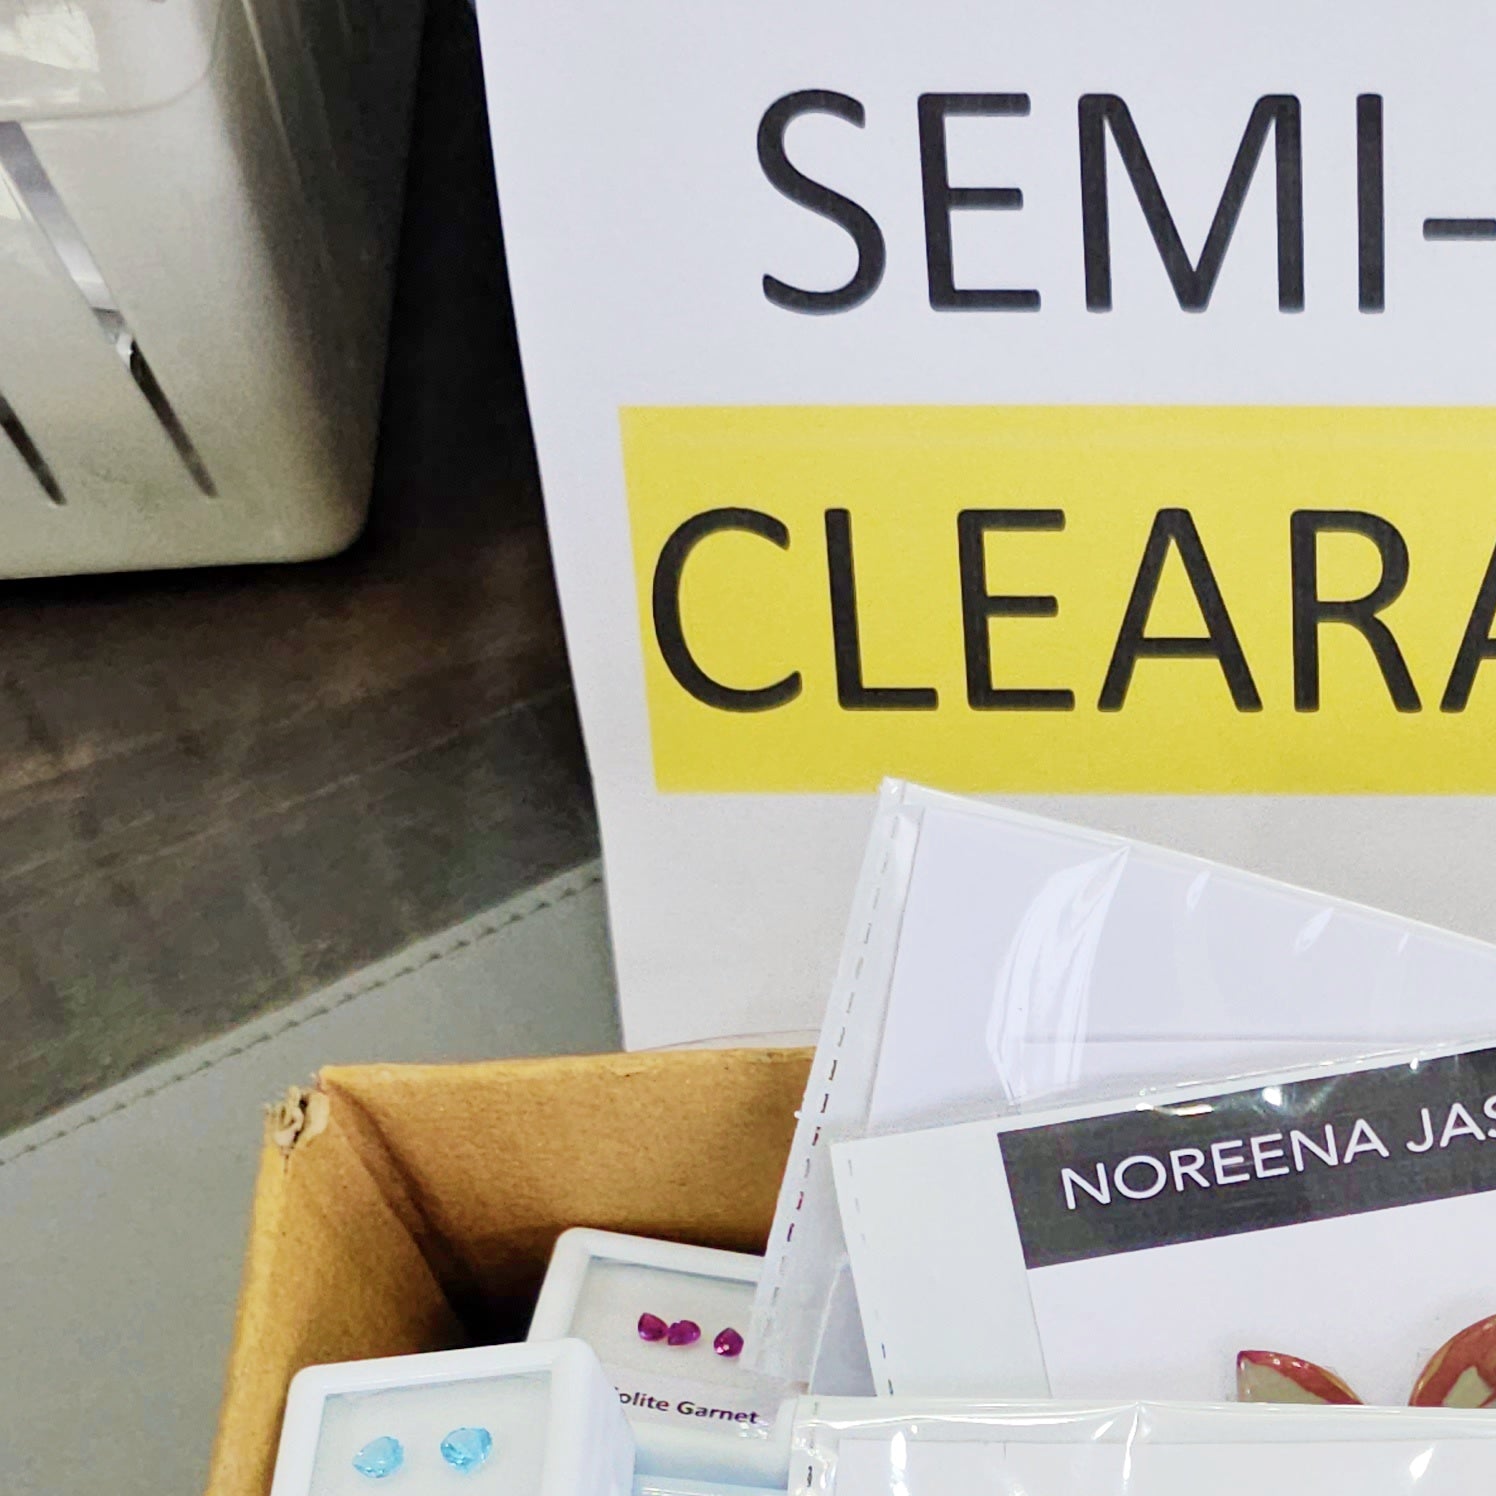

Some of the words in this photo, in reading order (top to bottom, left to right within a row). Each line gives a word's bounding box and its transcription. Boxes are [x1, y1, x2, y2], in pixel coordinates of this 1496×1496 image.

[1060, 1117, 1390, 1211] NOREENA
[613, 1386, 671, 1412] olite
[676, 1400, 761, 1425] Garnet
